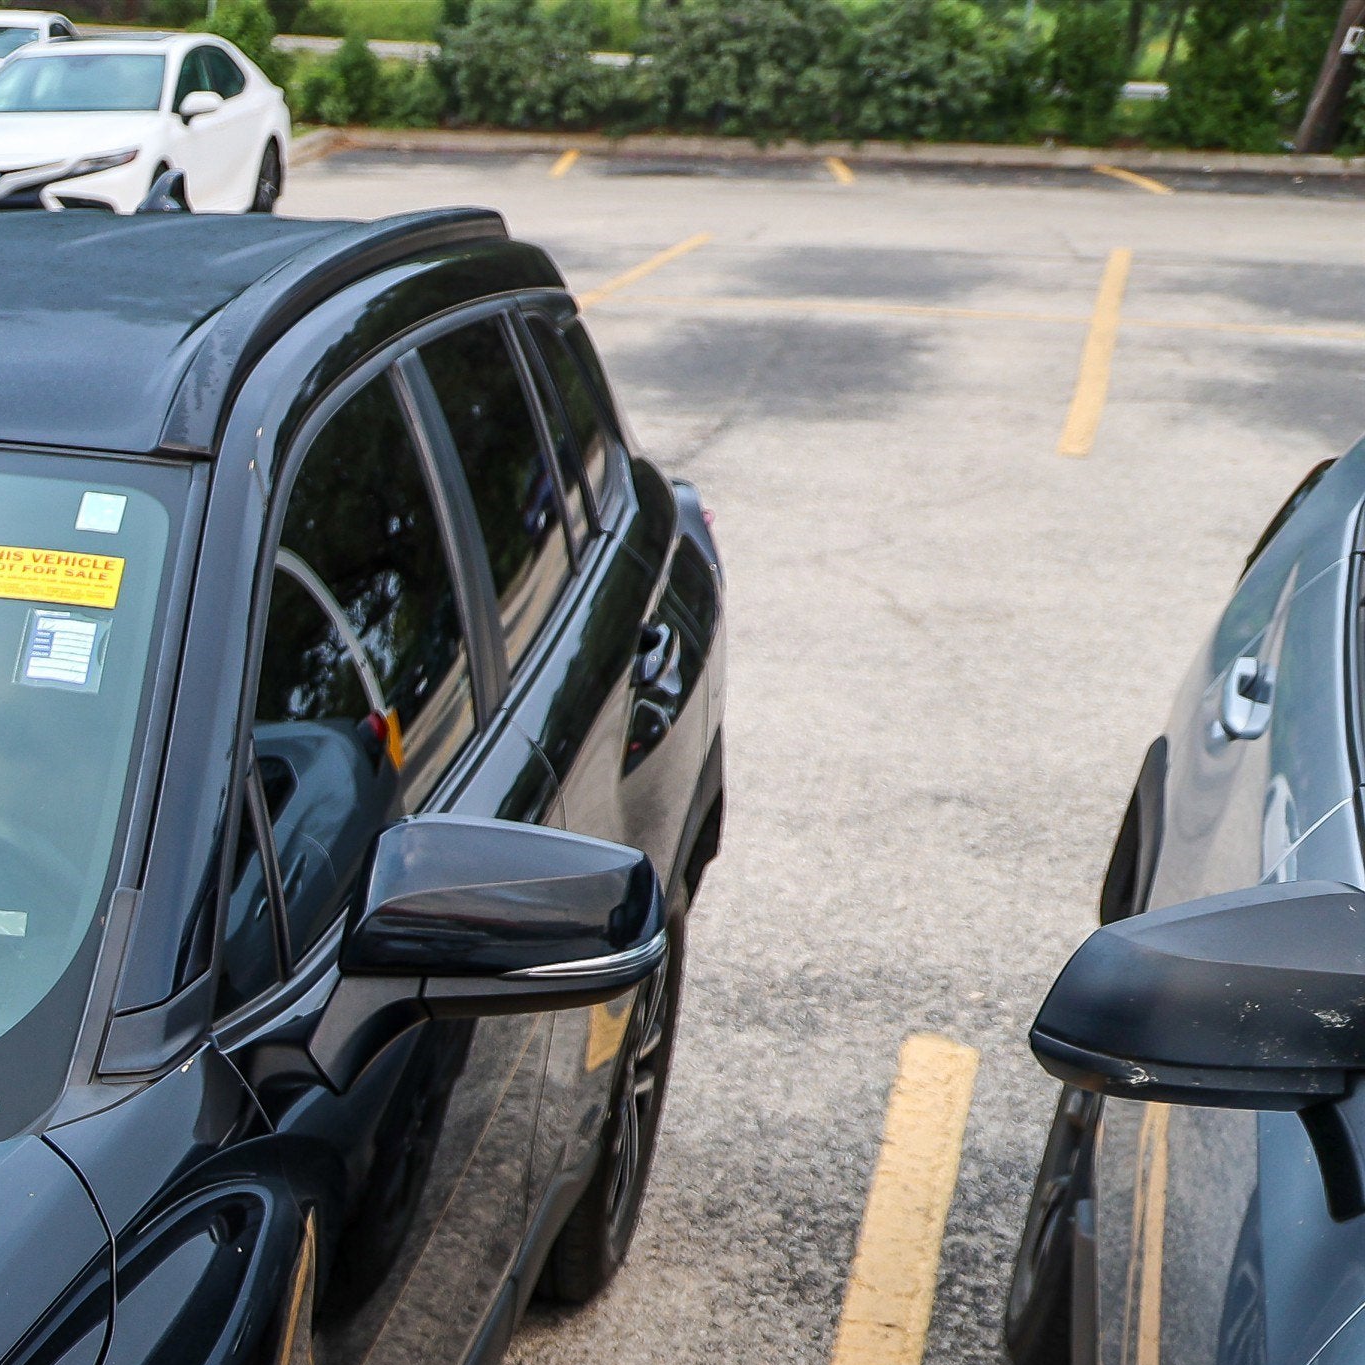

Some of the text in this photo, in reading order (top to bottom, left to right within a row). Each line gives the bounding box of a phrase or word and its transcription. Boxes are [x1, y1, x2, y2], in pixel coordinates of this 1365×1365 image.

[32, 551, 116, 571] VEHICLE
[22, 565, 58, 575] FOR
[64, 568, 108, 580] SALE
